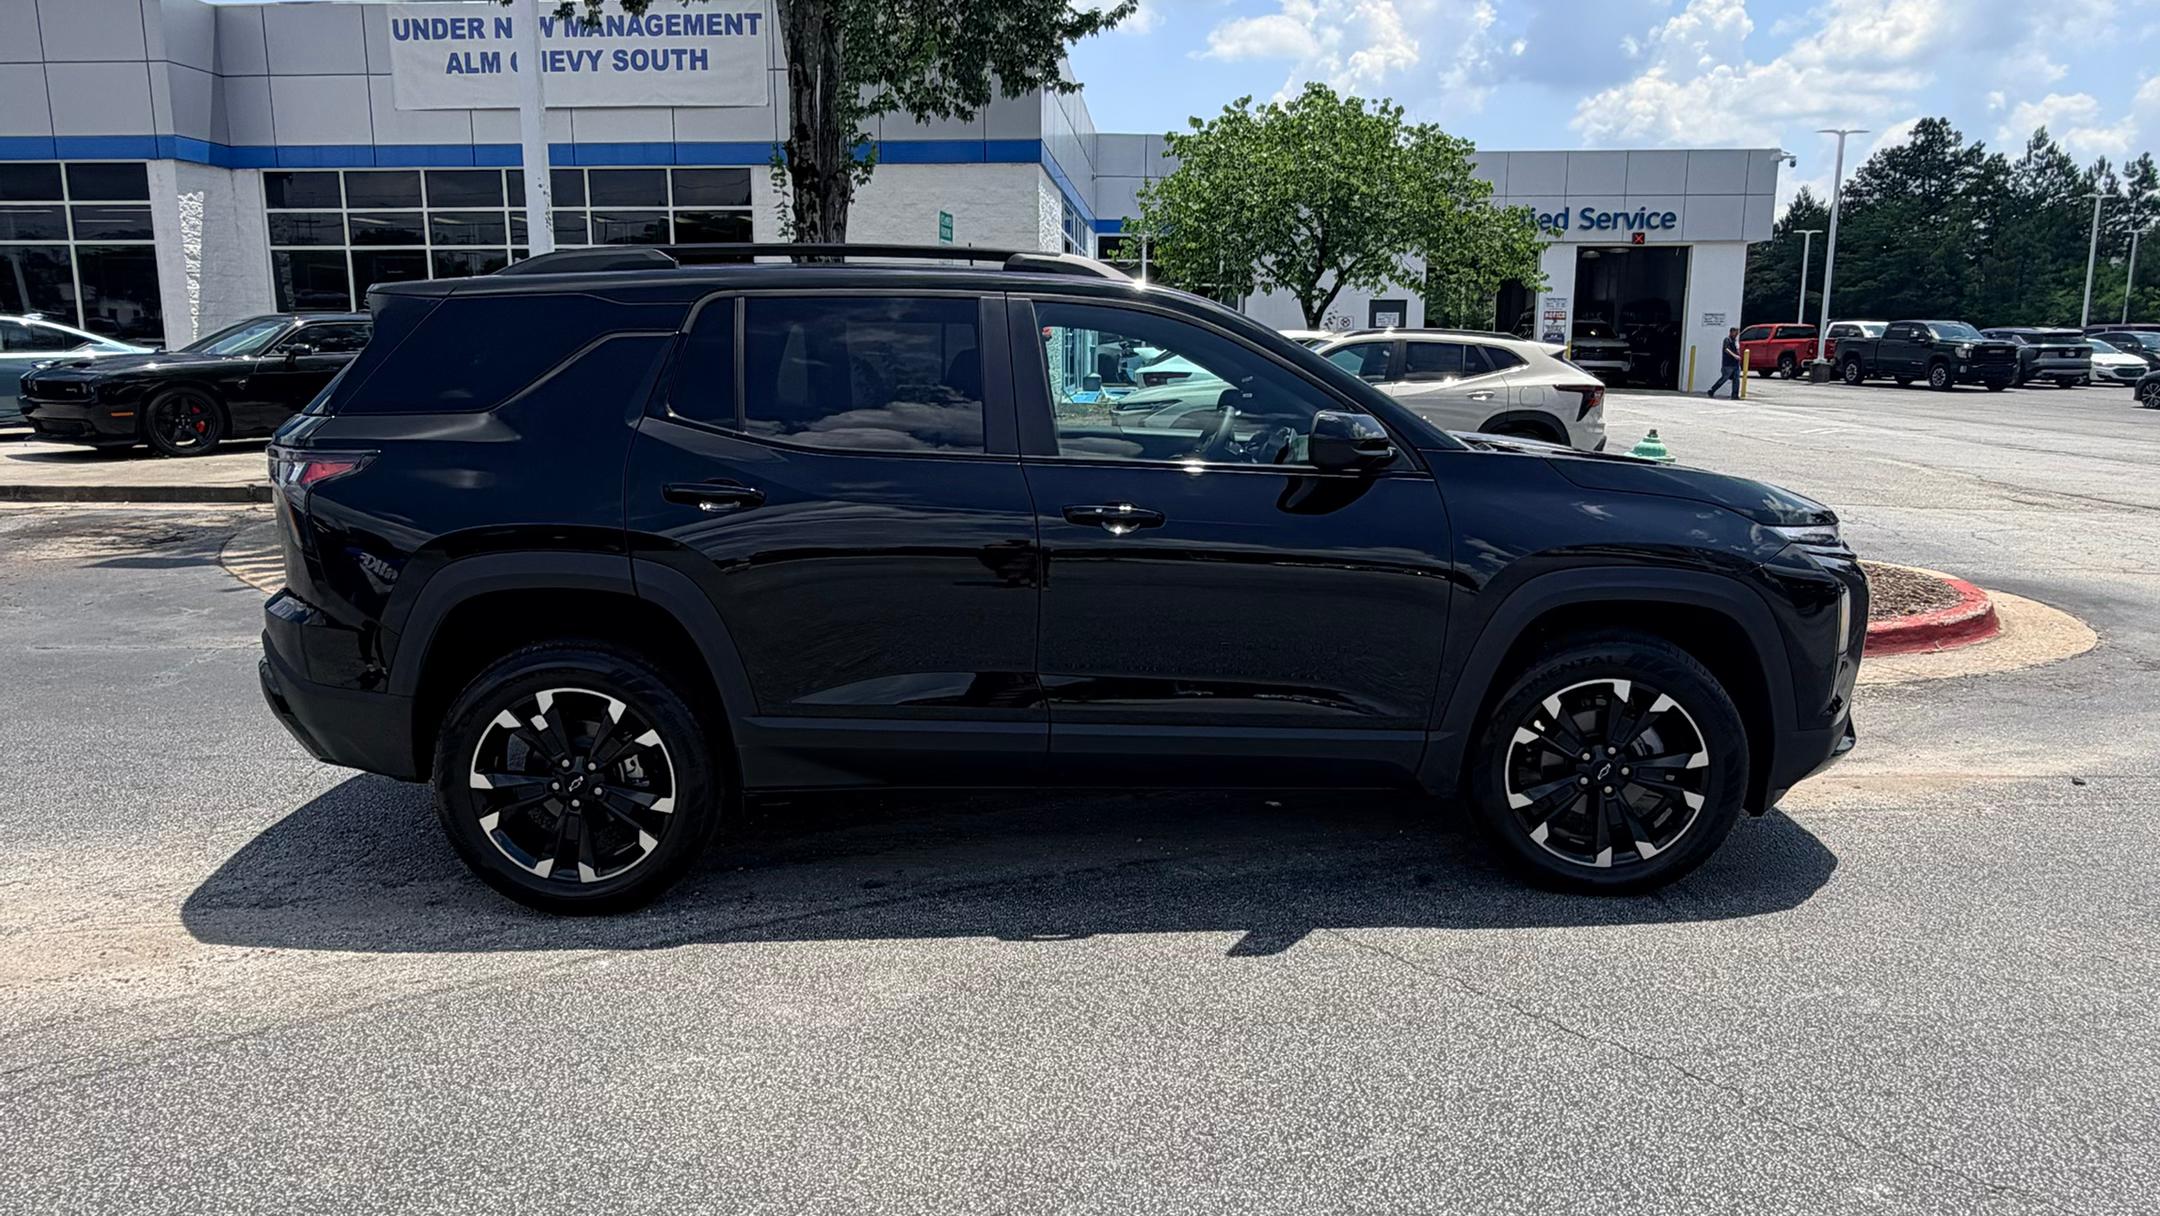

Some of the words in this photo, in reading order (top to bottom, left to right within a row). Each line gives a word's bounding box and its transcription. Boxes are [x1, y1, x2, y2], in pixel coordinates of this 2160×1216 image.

[392, 18, 487, 41] UNDER
[495, 17, 555, 40] NW
[564, 13, 762, 37] MANAGEMENT
[445, 52, 502, 75] ALM
[612, 48, 709, 72] SOUTH
[1577, 206, 1677, 231] Service
